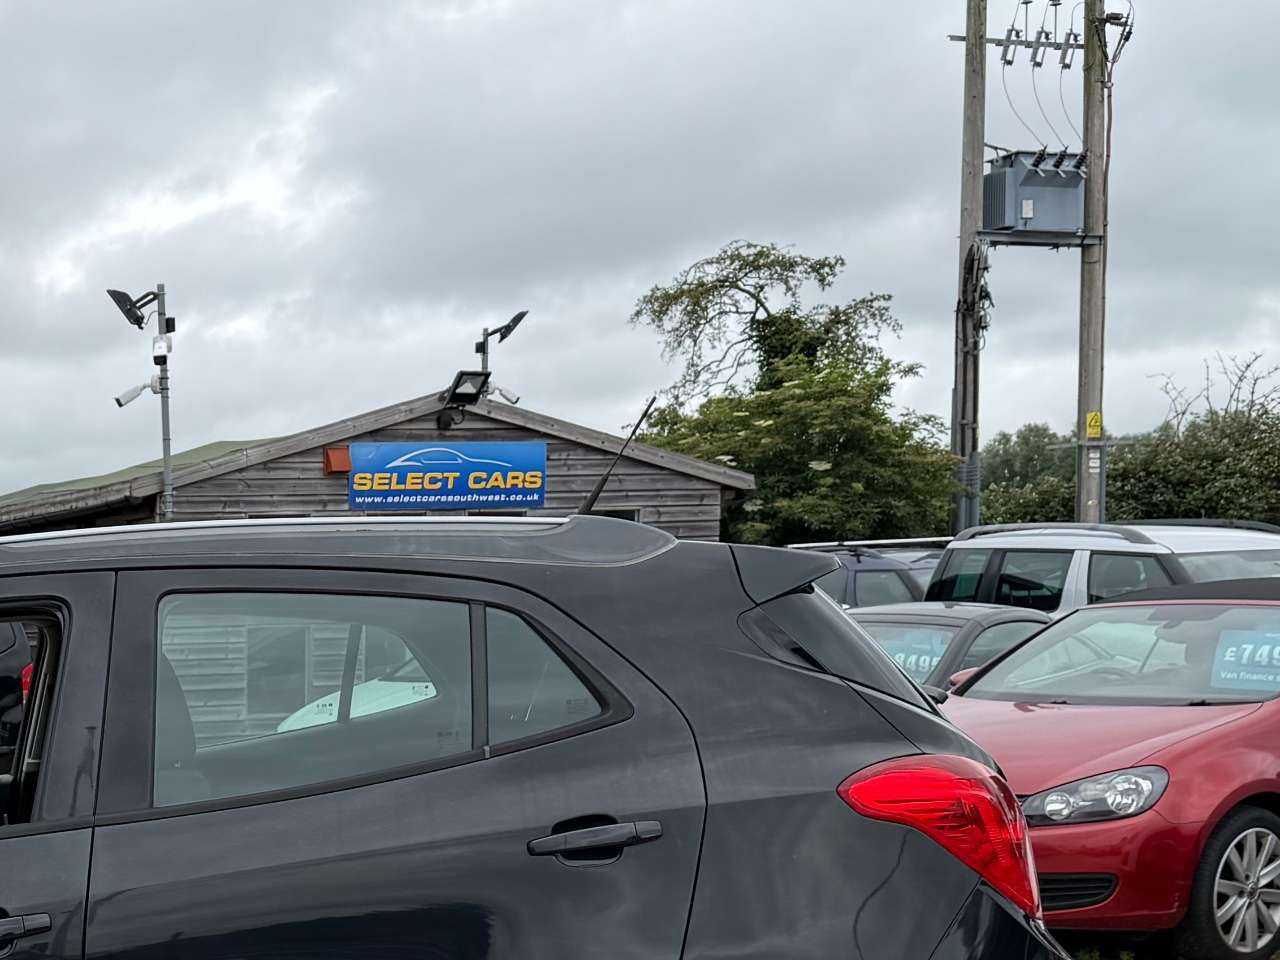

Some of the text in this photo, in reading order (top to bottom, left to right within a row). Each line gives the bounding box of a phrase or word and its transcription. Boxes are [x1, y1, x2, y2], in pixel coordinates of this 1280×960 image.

[353, 471, 543, 491] SELECT CARS
[355, 492, 540, 503] www.selectcarssouthwest.co.uk
[1220, 671, 1238, 680] Van
[1239, 671, 1274, 681] finance
